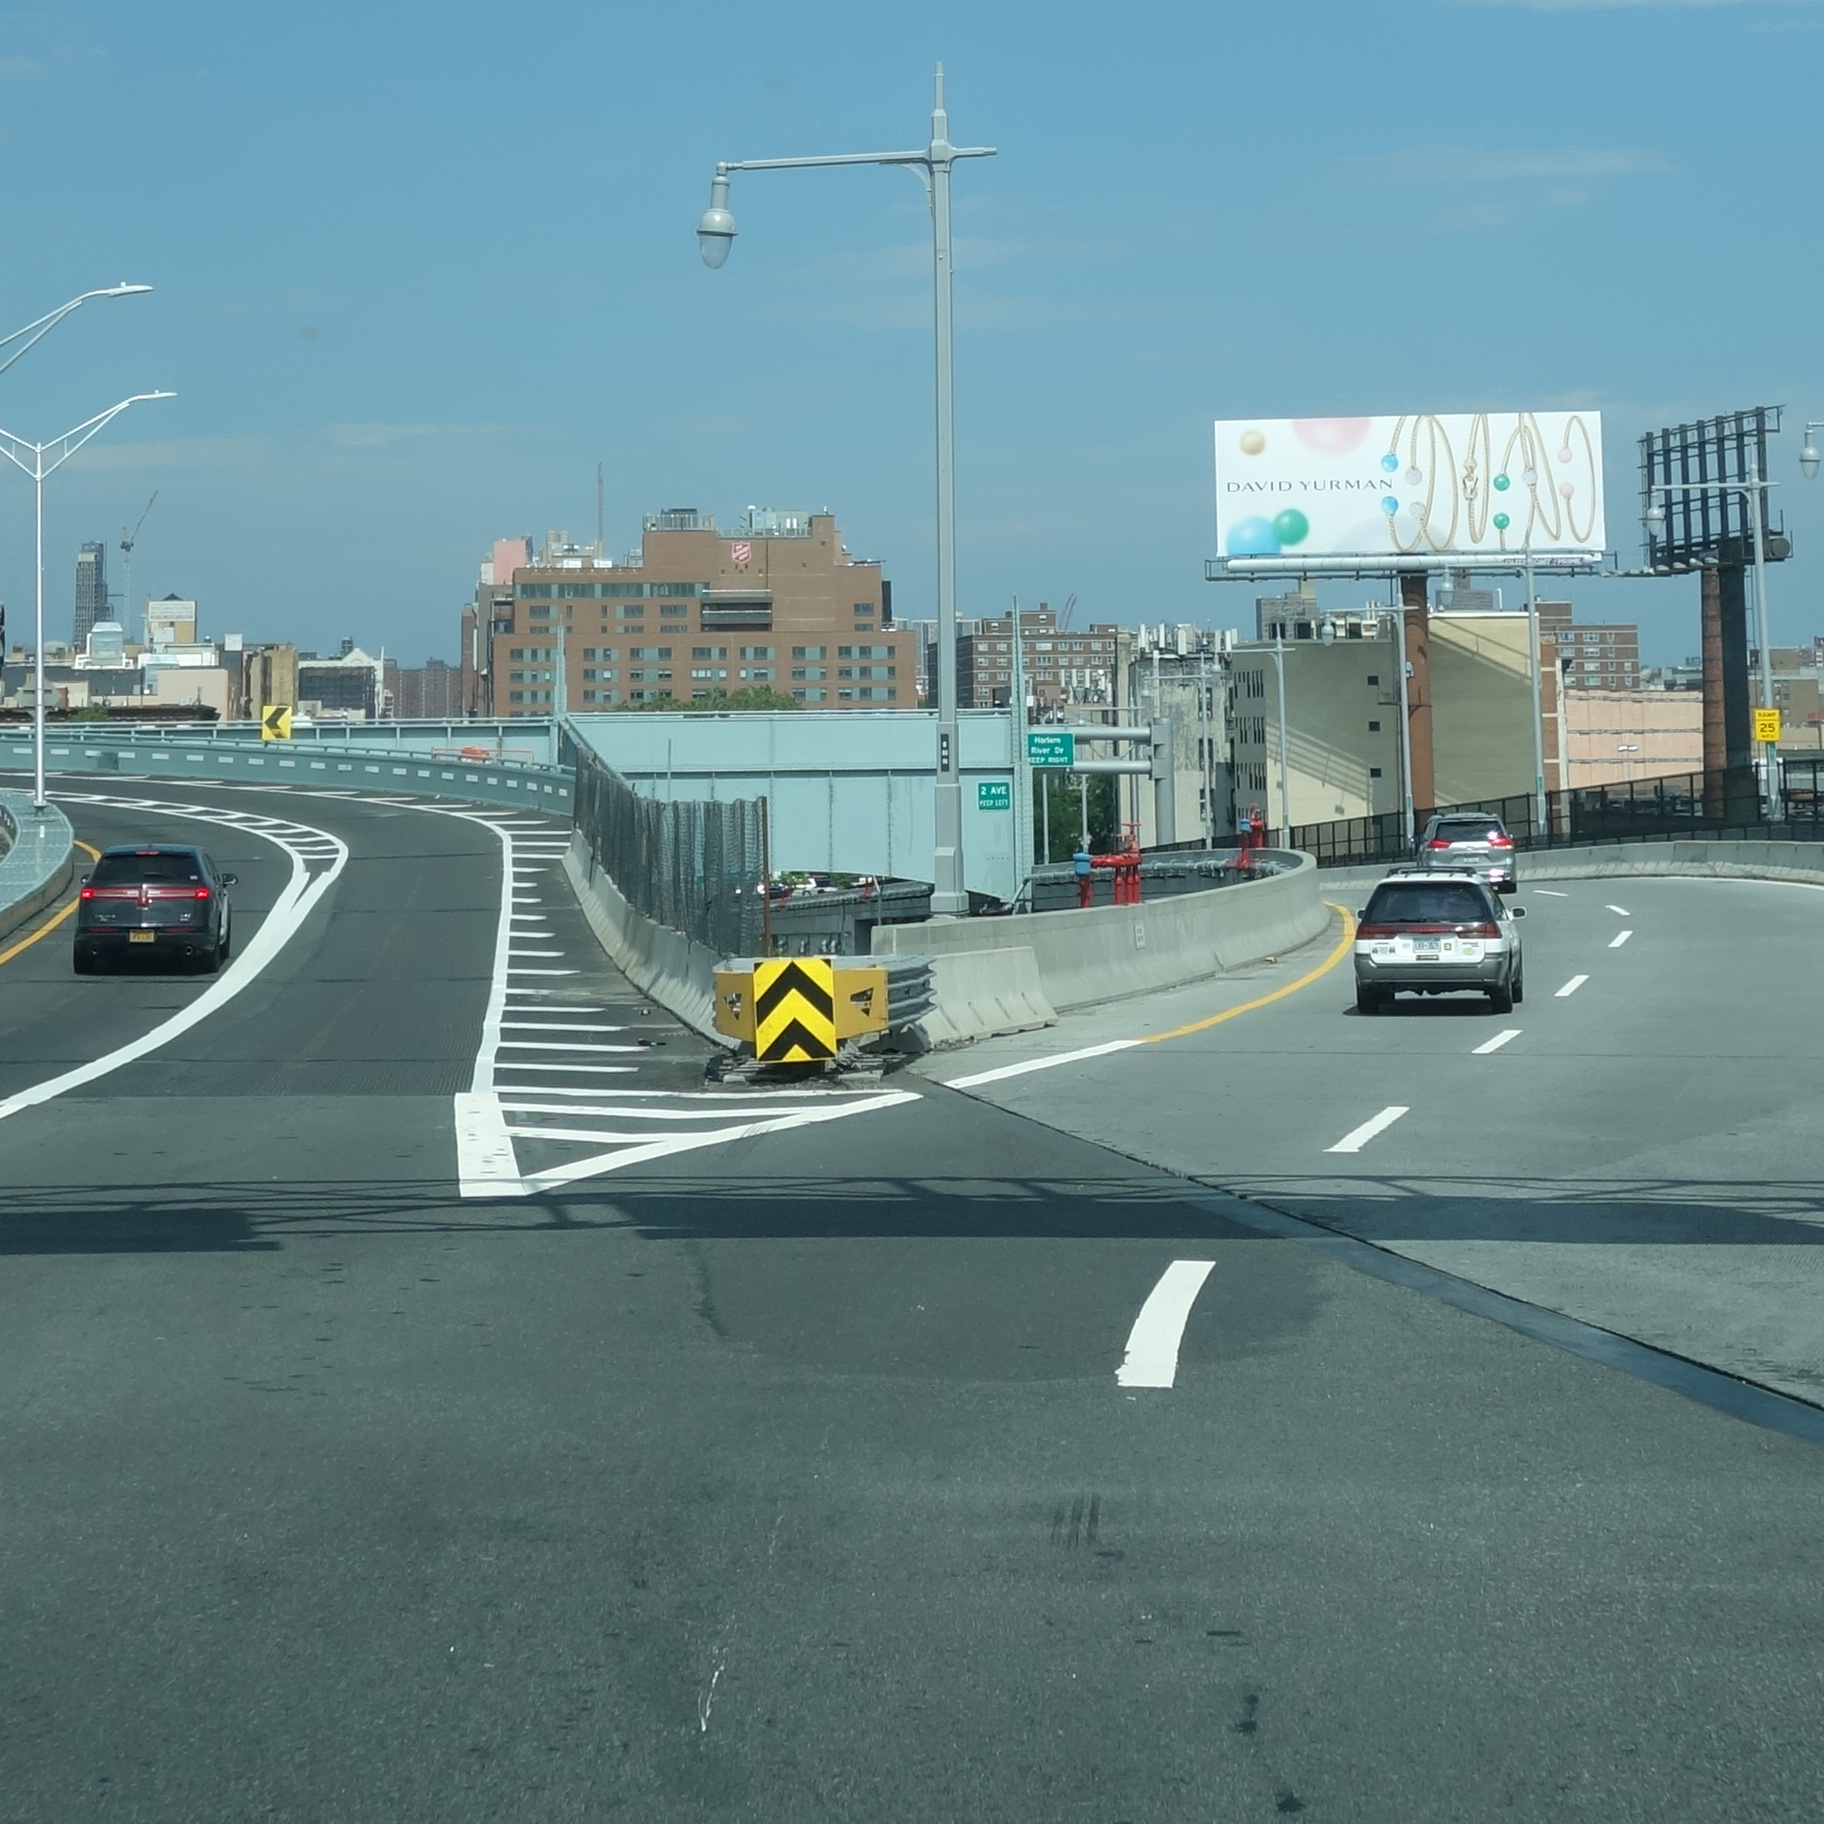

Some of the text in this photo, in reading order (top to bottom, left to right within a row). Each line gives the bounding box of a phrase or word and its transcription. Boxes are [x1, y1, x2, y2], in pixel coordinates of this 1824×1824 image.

[1227, 478, 1393, 493] DAVID YURMAN
[1760, 722, 1776, 733] 25
[1034, 736, 1061, 744] Harlem
[1030, 746, 1065, 754] River Dr
[980, 786, 1008, 795] 2 AVE
